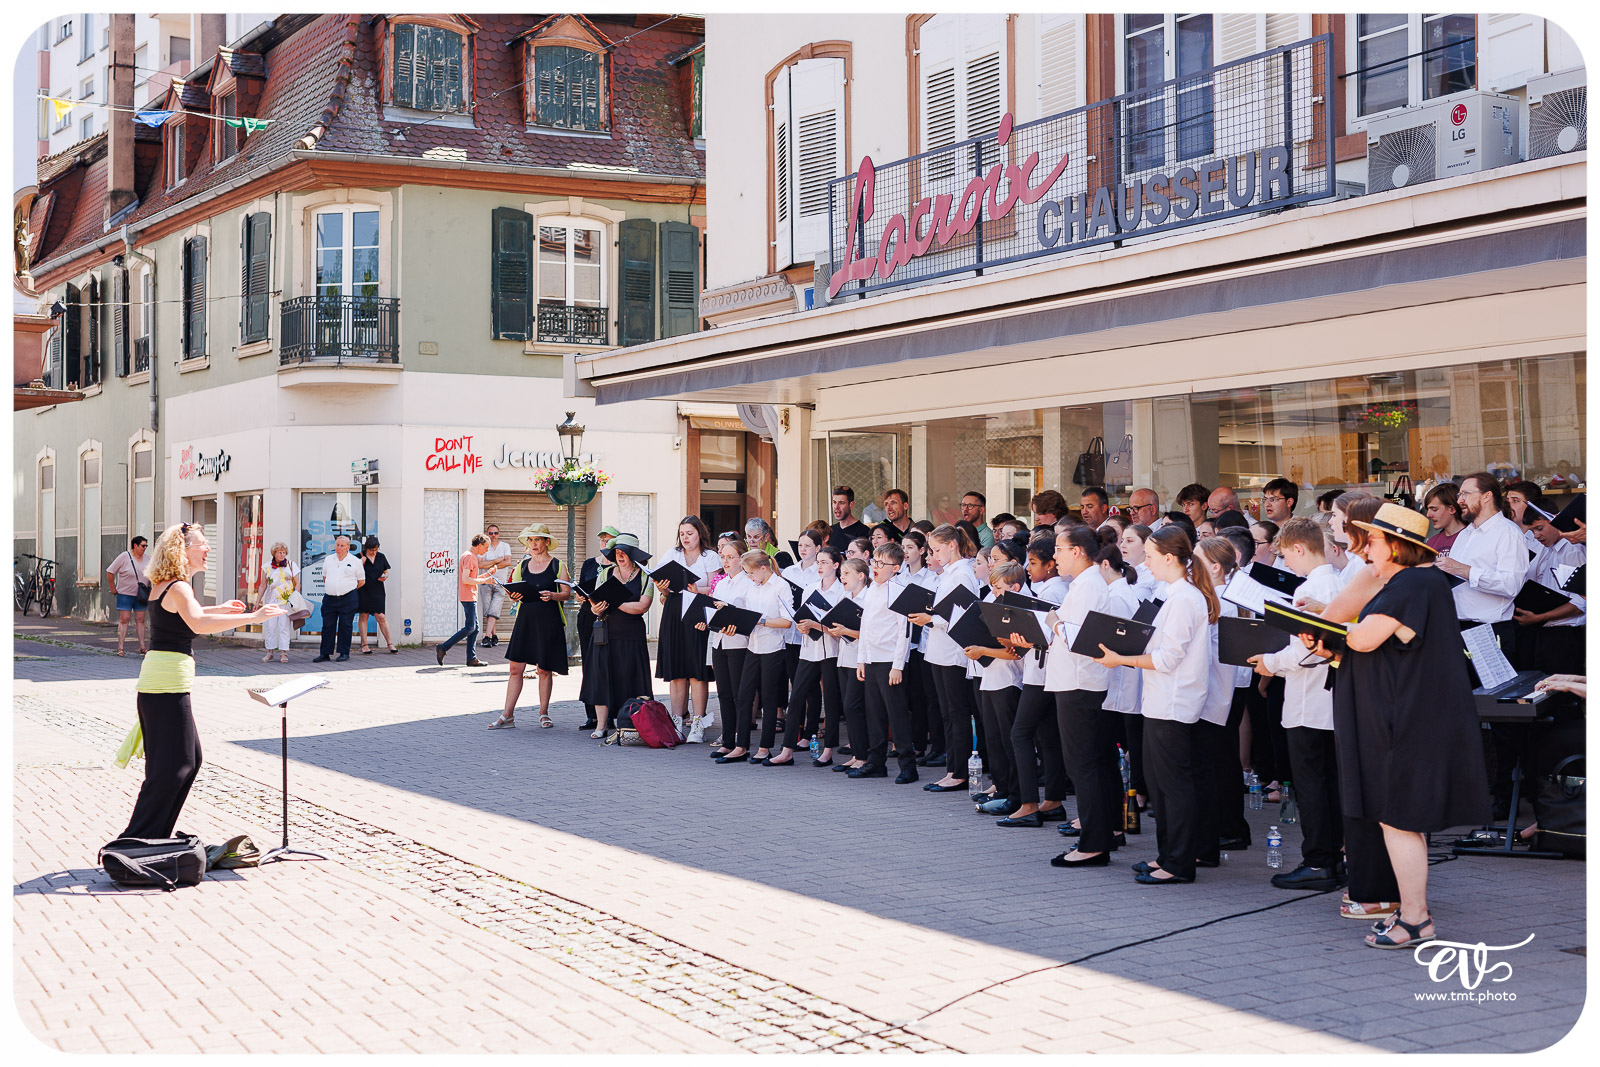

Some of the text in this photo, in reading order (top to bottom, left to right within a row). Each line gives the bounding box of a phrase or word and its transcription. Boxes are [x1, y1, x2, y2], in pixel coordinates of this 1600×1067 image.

[1452, 128, 1466, 142] LG
[830, 112, 1069, 299] Lacroix
[1037, 146, 1290, 248] CHAUSSEUR
[434, 435, 474, 453] DON'T
[425, 453, 483, 474] CALL ME
[308, 520, 356, 536] SEE
